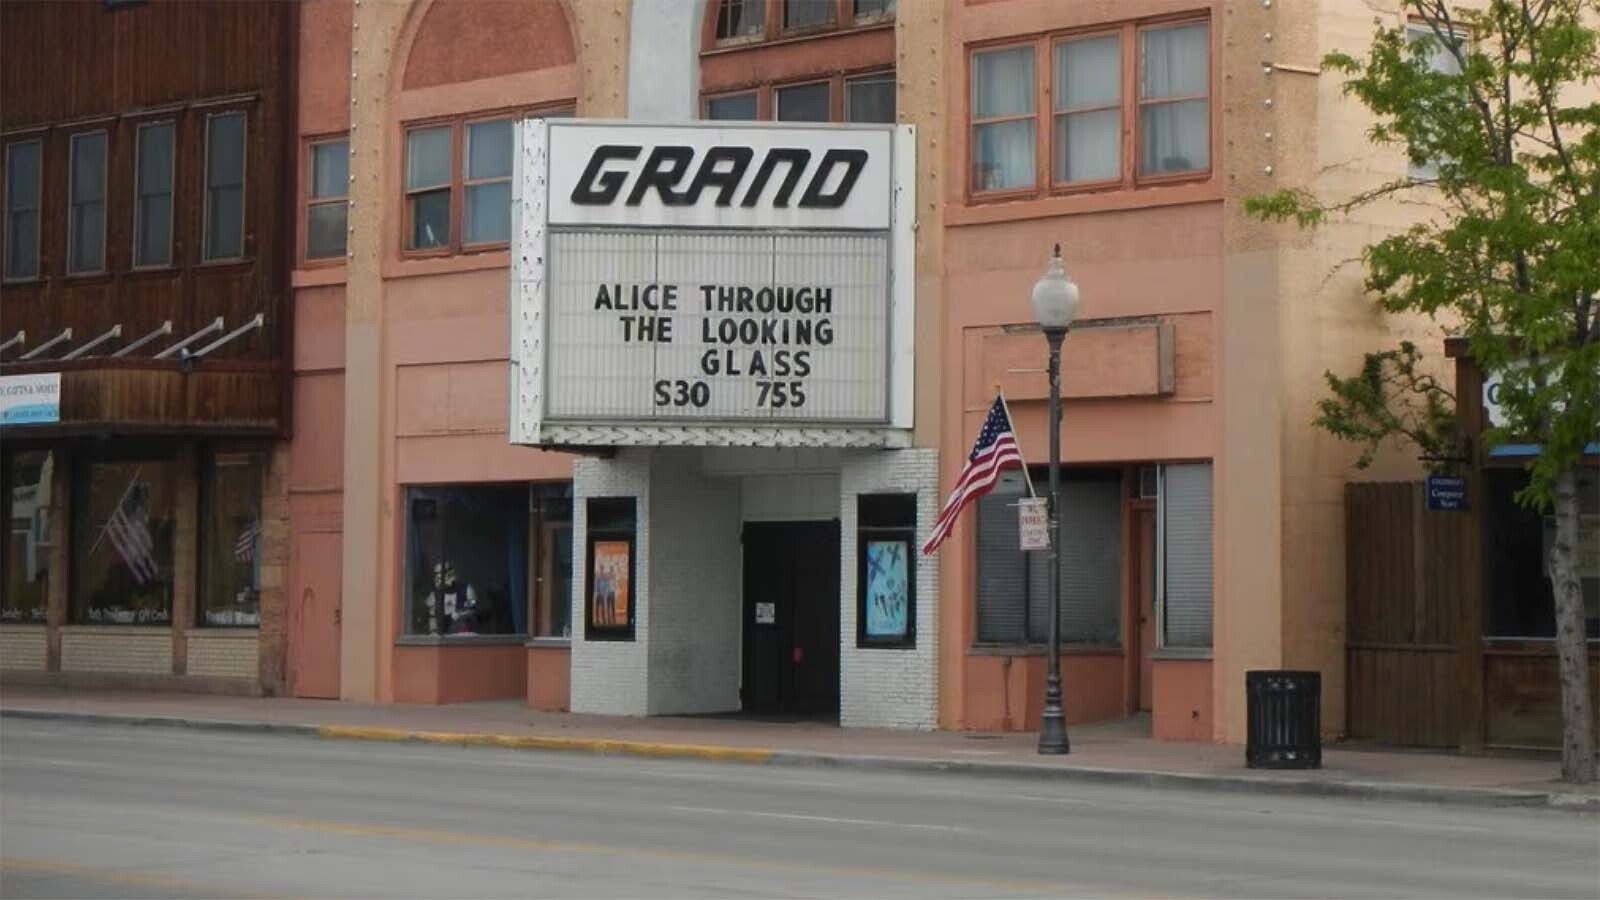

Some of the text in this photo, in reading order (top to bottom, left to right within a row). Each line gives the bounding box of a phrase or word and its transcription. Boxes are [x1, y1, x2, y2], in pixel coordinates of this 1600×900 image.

[571, 145, 868, 209] GRAND
[595, 284, 832, 314] ALICE THROUGH
[620, 316, 834, 346] THE LOOKING
[701, 349, 811, 377] GLASS
[756, 381, 806, 408] 755
